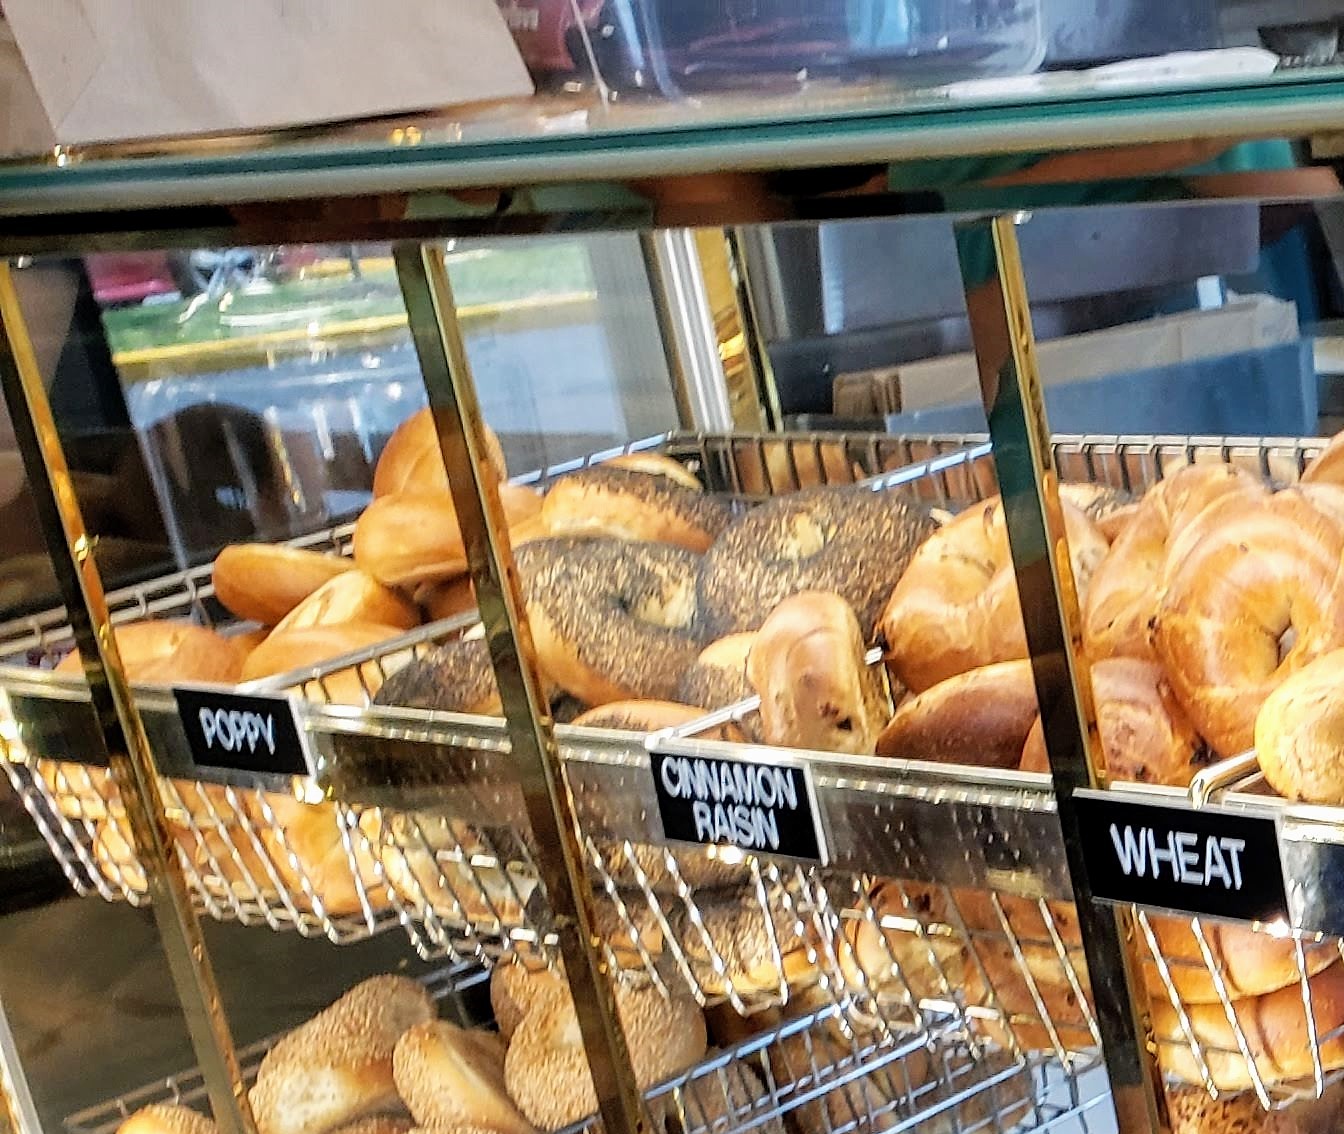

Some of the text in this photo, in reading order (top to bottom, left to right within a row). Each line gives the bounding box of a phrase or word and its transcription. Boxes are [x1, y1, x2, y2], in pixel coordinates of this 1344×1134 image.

[199, 707, 275, 756] POPPY
[661, 757, 797, 809] CINNAMON
[692, 801, 780, 850] RAISIN
[1110, 824, 1246, 891] WHEAT
